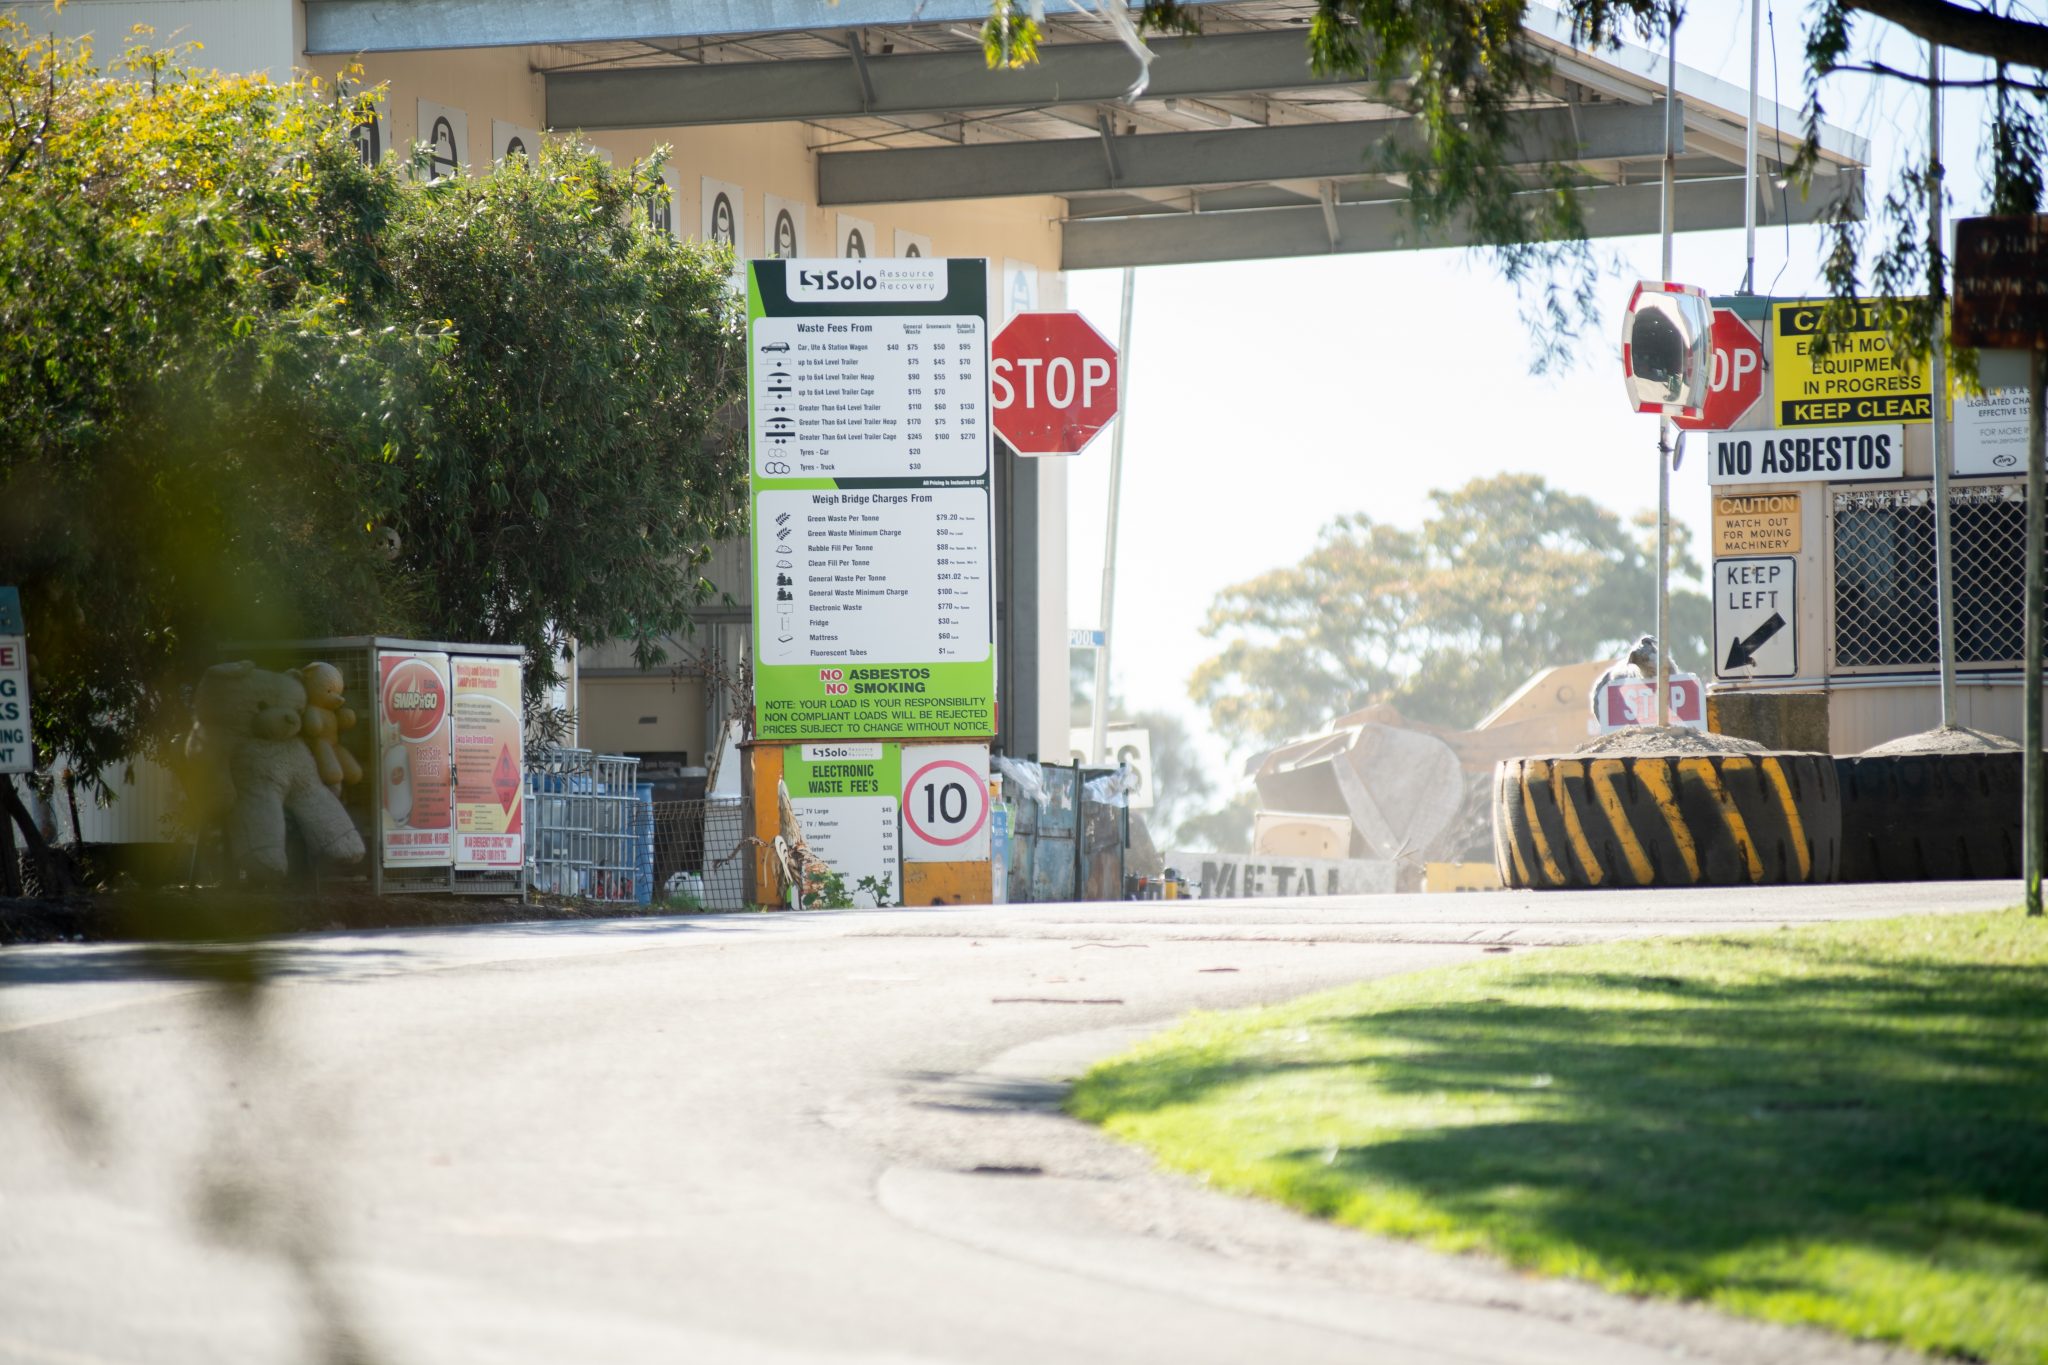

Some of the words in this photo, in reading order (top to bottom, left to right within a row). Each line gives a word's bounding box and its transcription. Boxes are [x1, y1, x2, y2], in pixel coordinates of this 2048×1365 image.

[827, 270, 877, 290] Solo
[880, 270, 934, 278] Resource
[880, 281, 935, 291] Recovery
[797, 324, 824, 332] Waste
[828, 324, 848, 332] Fees
[851, 323, 872, 332] From
[1796, 340, 1853, 355] ETH
[1710, 348, 1757, 393] OP
[1812, 358, 1902, 374] EQUIPMEN
[992, 357, 1110, 409] STOP
[1804, 381, 1819, 394] IN
[1826, 376, 1921, 393] PROGRESS
[1794, 402, 1851, 420] KEEP
[1857, 398, 1930, 417] CLEAR
[1979, 408, 2016, 417] EFFECTIVE
[883, 418, 897, 426] Heap
[883, 433, 896, 441] Cage
[1718, 441, 1752, 476] NO
[1762, 434, 1892, 474] ASBESTOS
[812, 495, 839, 505] Weigh
[842, 494, 869, 505] Bridge
[872, 494, 908, 504] Charges
[911, 494, 932, 502] From
[1720, 496, 1794, 514] CAUTION
[1726, 520, 1760, 528] WATCH
[1768, 518, 1788, 526] OUT
[880, 529, 901, 537] Charge
[1724, 531, 1743, 539] FOR
[1751, 529, 1791, 538] MOVING
[1726, 540, 1789, 550] MACHINERY
[1728, 566, 1781, 584] KEEP
[1730, 591, 1778, 610] LEFT
[821, 670, 842, 680] NO
[850, 668, 930, 680] ASBESTOS
[826, 683, 848, 695] NO
[854, 682, 926, 694] SMOKING
[766, 701, 796, 709] NOTE:
[800, 700, 827, 709] YOUR
[830, 700, 857, 708] LOAD
[860, 699, 869, 708] IS
[875, 699, 901, 708] YOUR
[904, 697, 986, 707] RESPONSIBILITY
[1623, 685, 1686, 720] STP
[765, 713, 787, 722] NON
[791, 712, 851, 721] COMPLIANT
[854, 711, 887, 720] LOADS
[891, 711, 915, 720] WILL
[919, 711, 932, 719] BE
[936, 710, 988, 719] REJECTED
[763, 725, 797, 734] PRICES
[800, 724, 843, 733] SUBJECT
[847, 724, 860, 732] TO
[864, 723, 903, 732] CHANGE
[907, 722, 950, 731] WITHOUT
[954, 721, 988, 731] NOTICE
[825, 748, 848, 757] Solo
[812, 764, 874, 778] ELECTRONIC
[809, 780, 843, 793] WASTE
[850, 780, 878, 792] FEE'S
[924, 782, 967, 823] 10
